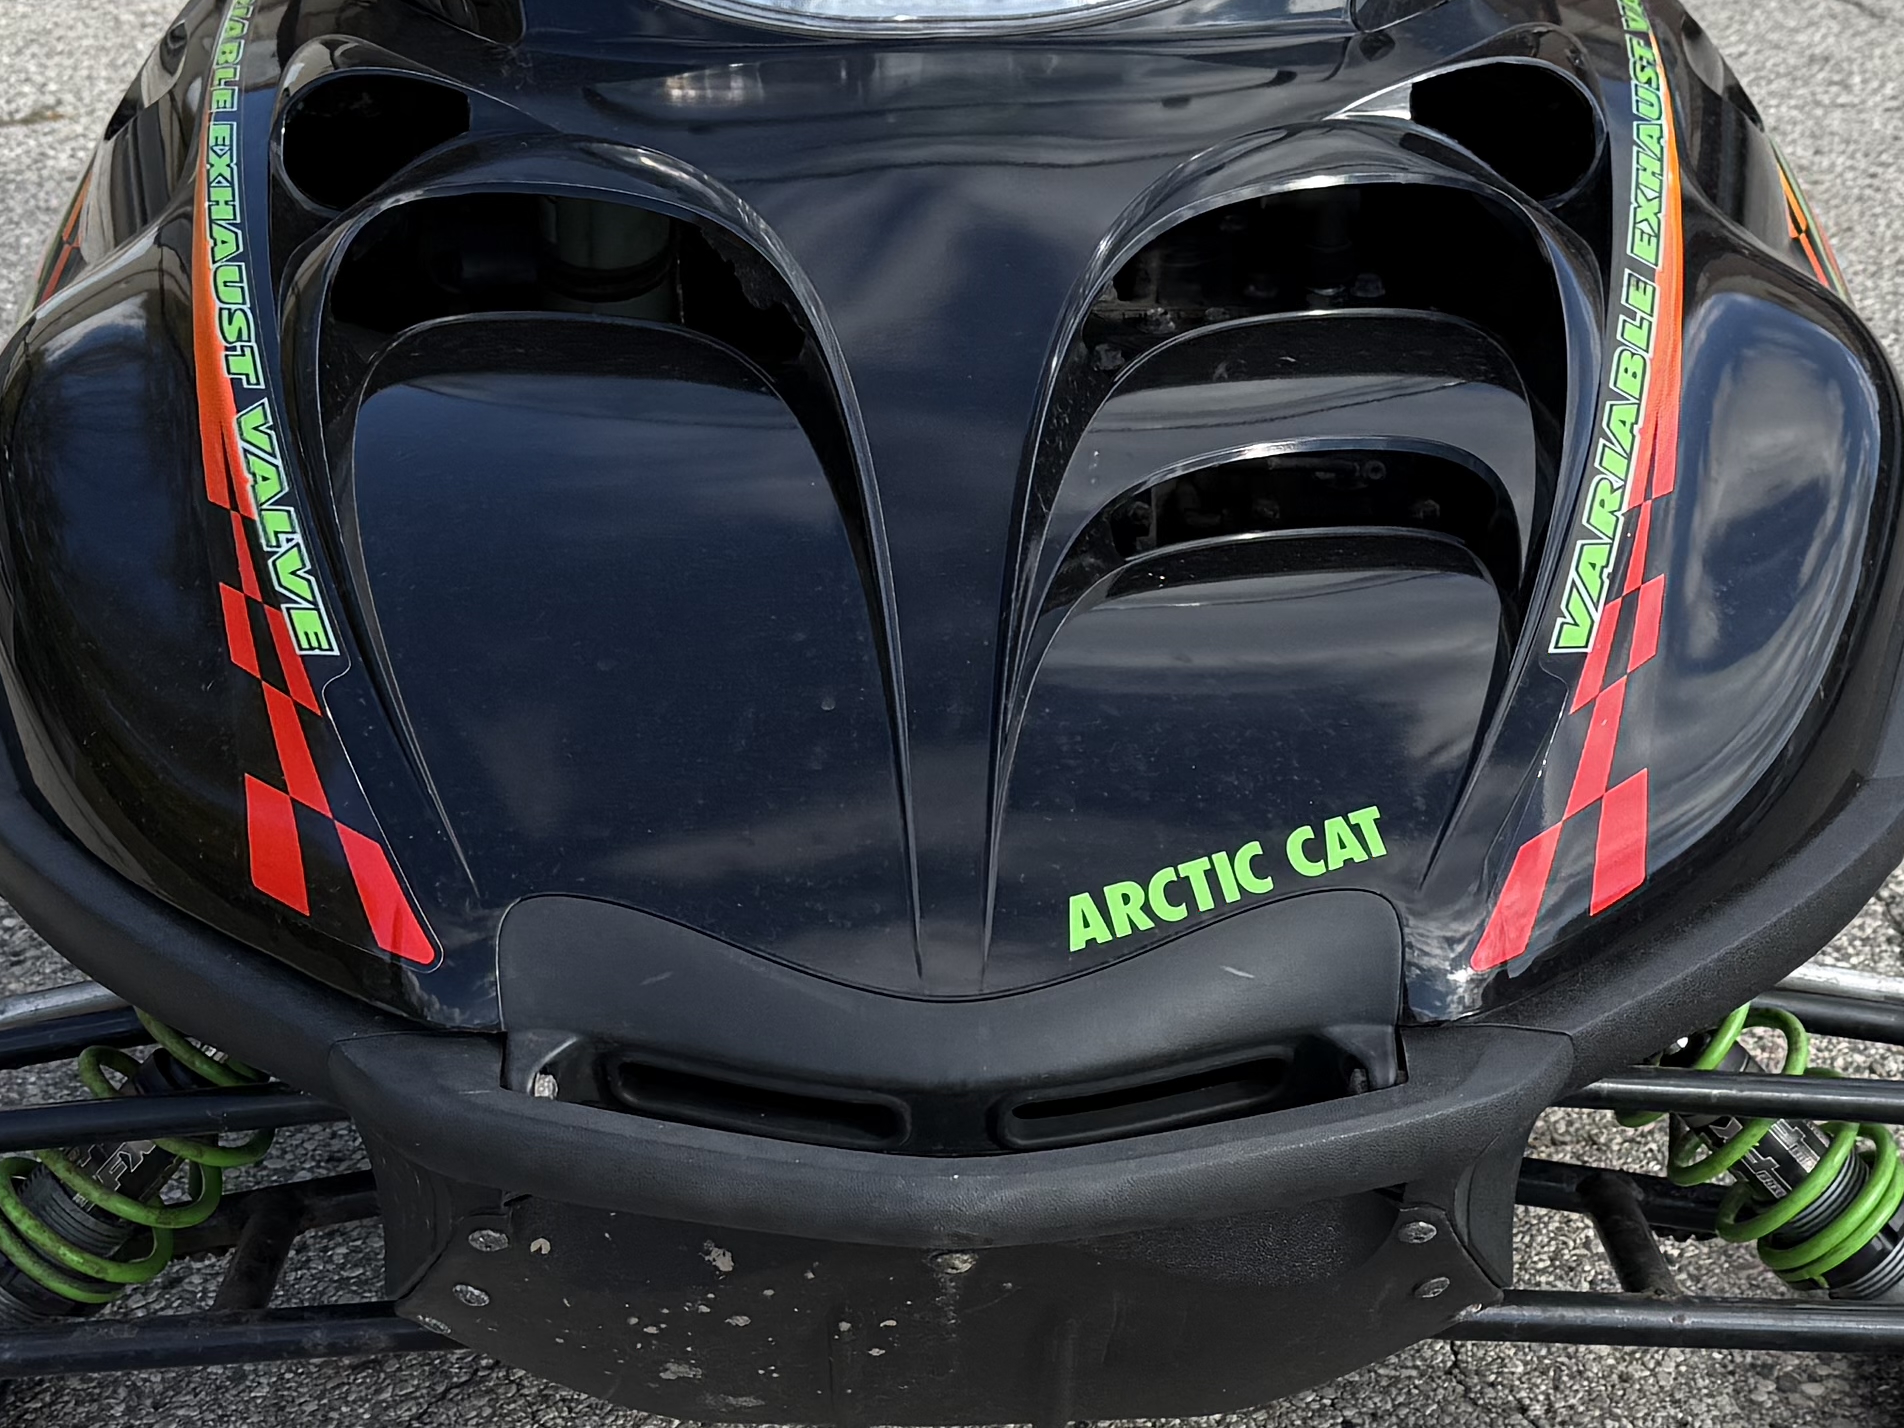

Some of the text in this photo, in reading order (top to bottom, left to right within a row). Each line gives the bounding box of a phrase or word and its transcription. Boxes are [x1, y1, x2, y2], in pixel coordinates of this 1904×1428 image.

[202, 120, 267, 390] EXHAUST
[1547, 267, 1656, 654] VARIABLE
[1625, 33, 1669, 268] EXHAUST
[234, 397, 340, 656] VALVE
[1068, 805, 1388, 953] ARCTIC CAT
